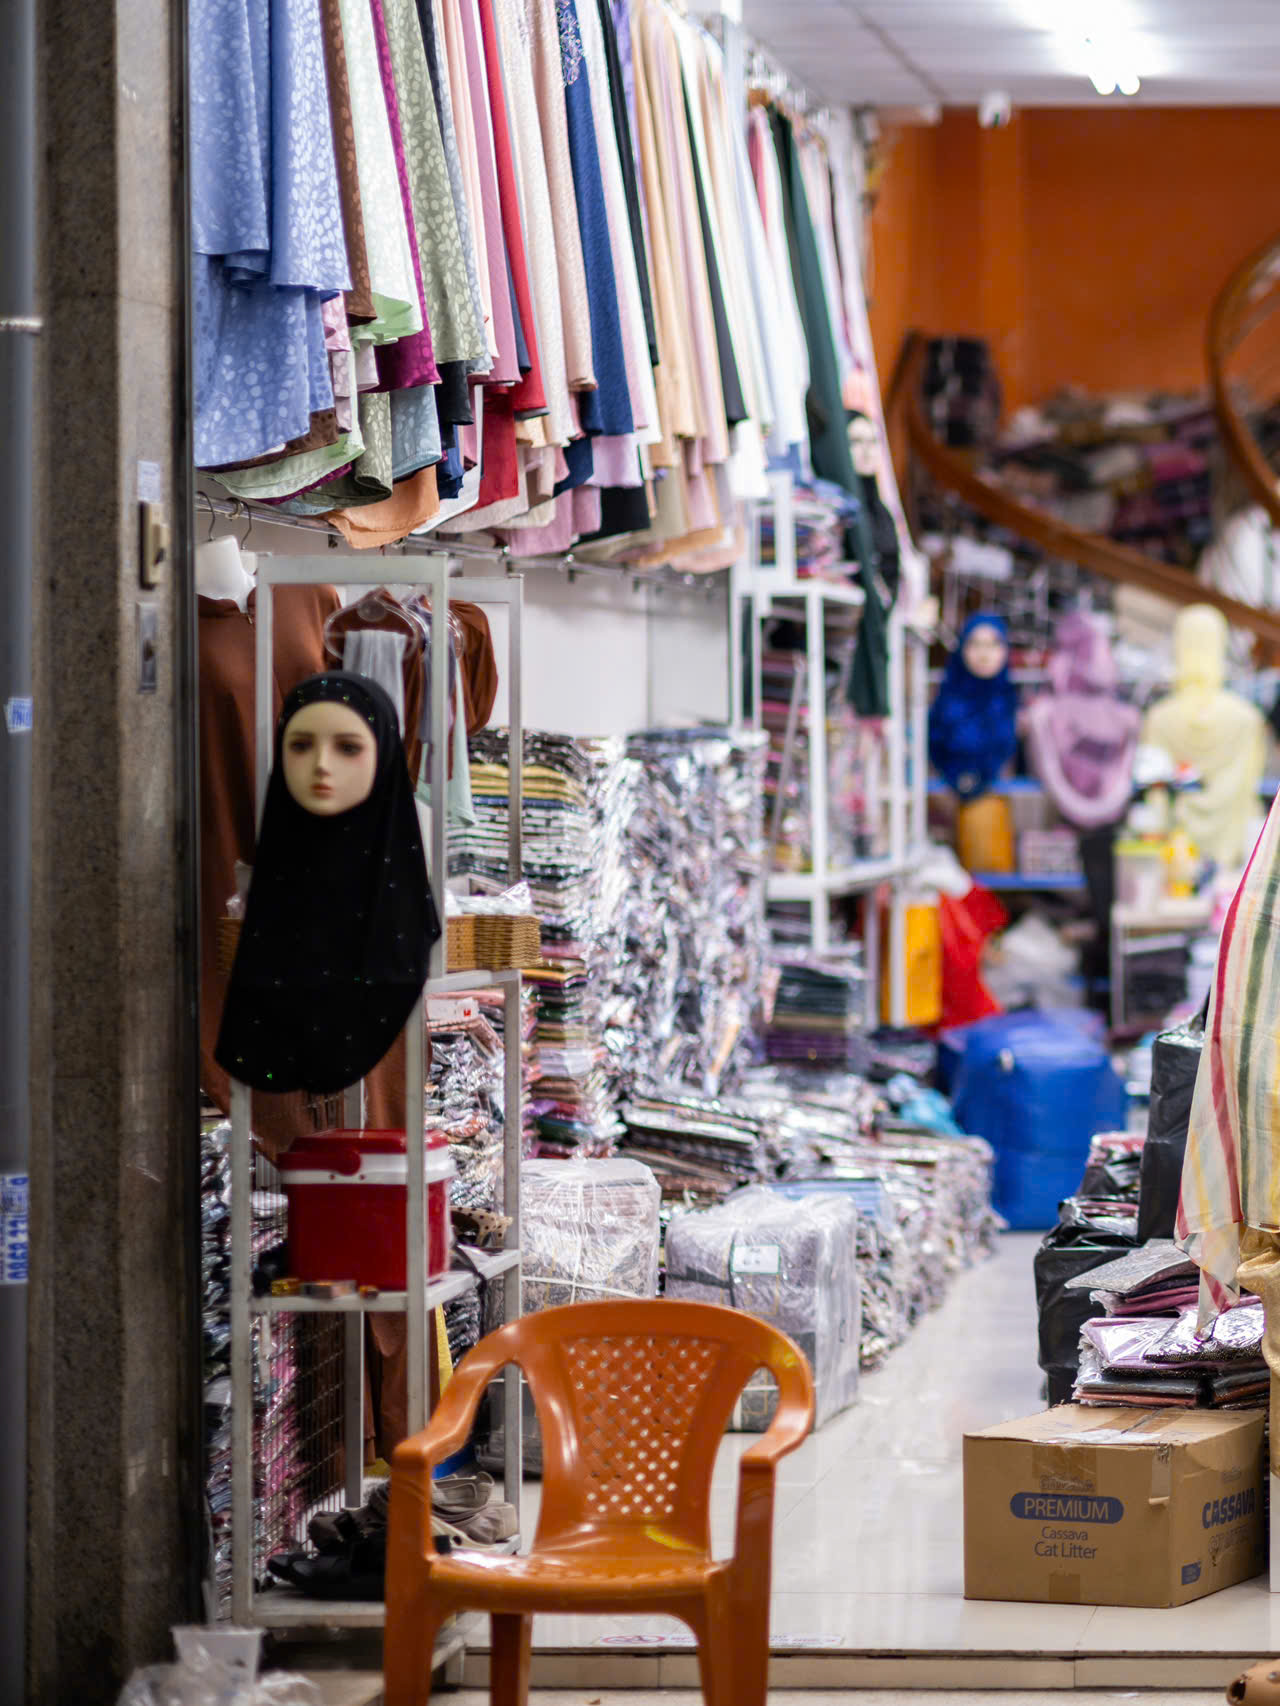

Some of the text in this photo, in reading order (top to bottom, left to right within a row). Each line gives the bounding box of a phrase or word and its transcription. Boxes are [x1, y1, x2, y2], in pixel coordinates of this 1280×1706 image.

[1024, 1497, 1110, 1521] PREMIUM
[1202, 1487, 1256, 1529] CASSAVA
[1041, 1526, 1089, 1541] Cassava
[1034, 1541, 1098, 1559] Cat Litter
